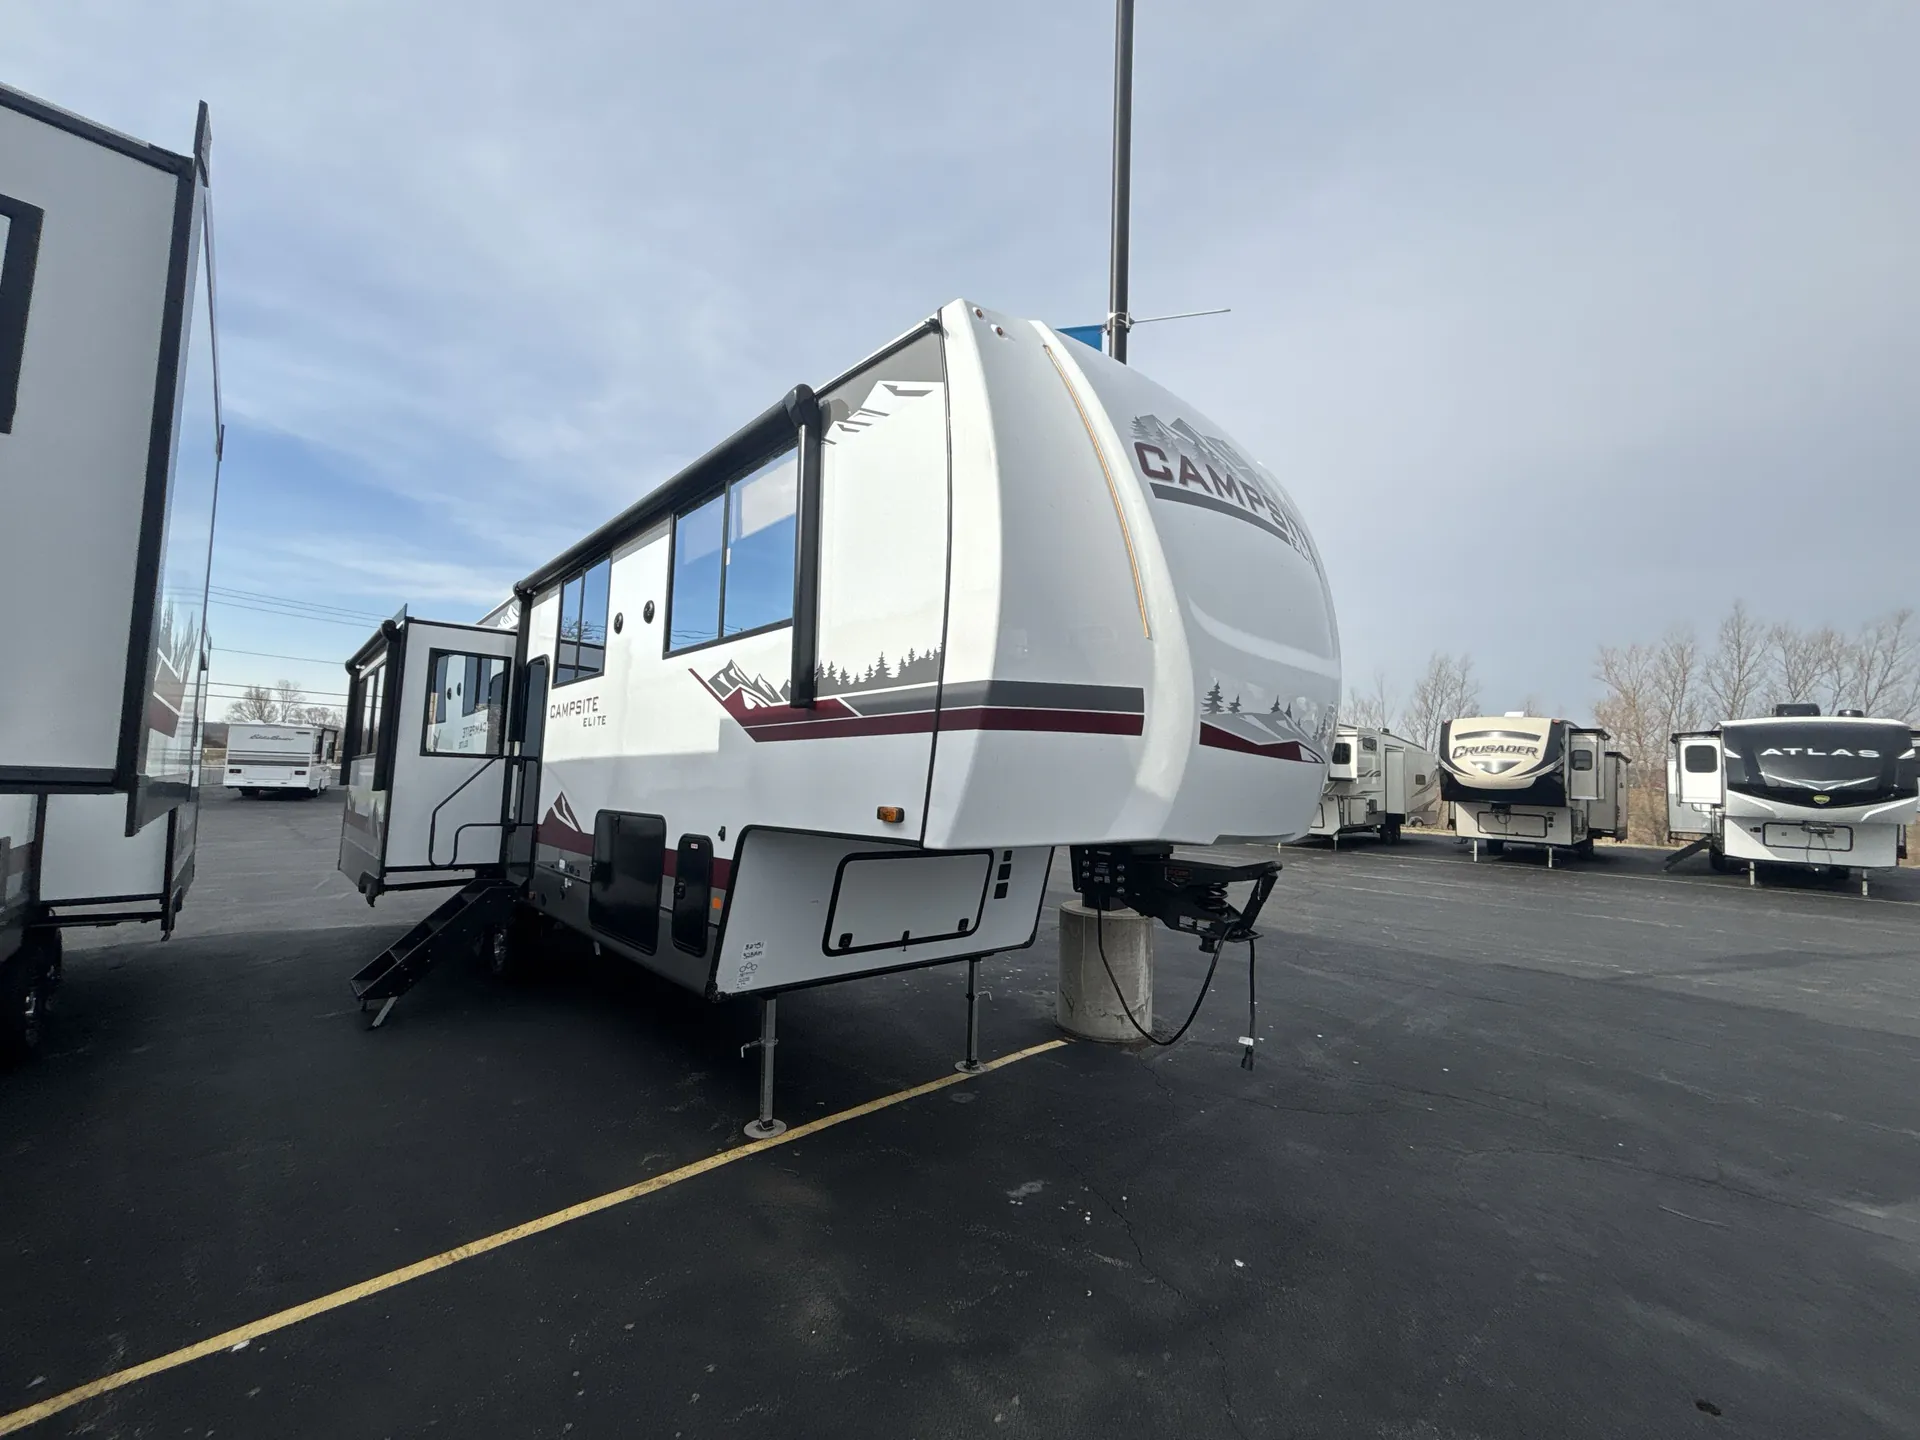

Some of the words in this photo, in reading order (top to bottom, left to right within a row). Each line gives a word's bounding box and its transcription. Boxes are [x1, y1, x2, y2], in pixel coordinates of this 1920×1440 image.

[550, 696, 599, 719] CAMPSITE
[583, 715, 606, 727] ELITE
[1452, 745, 1540, 759] CRUSADER
[1760, 748, 1880, 758] ATLAS
